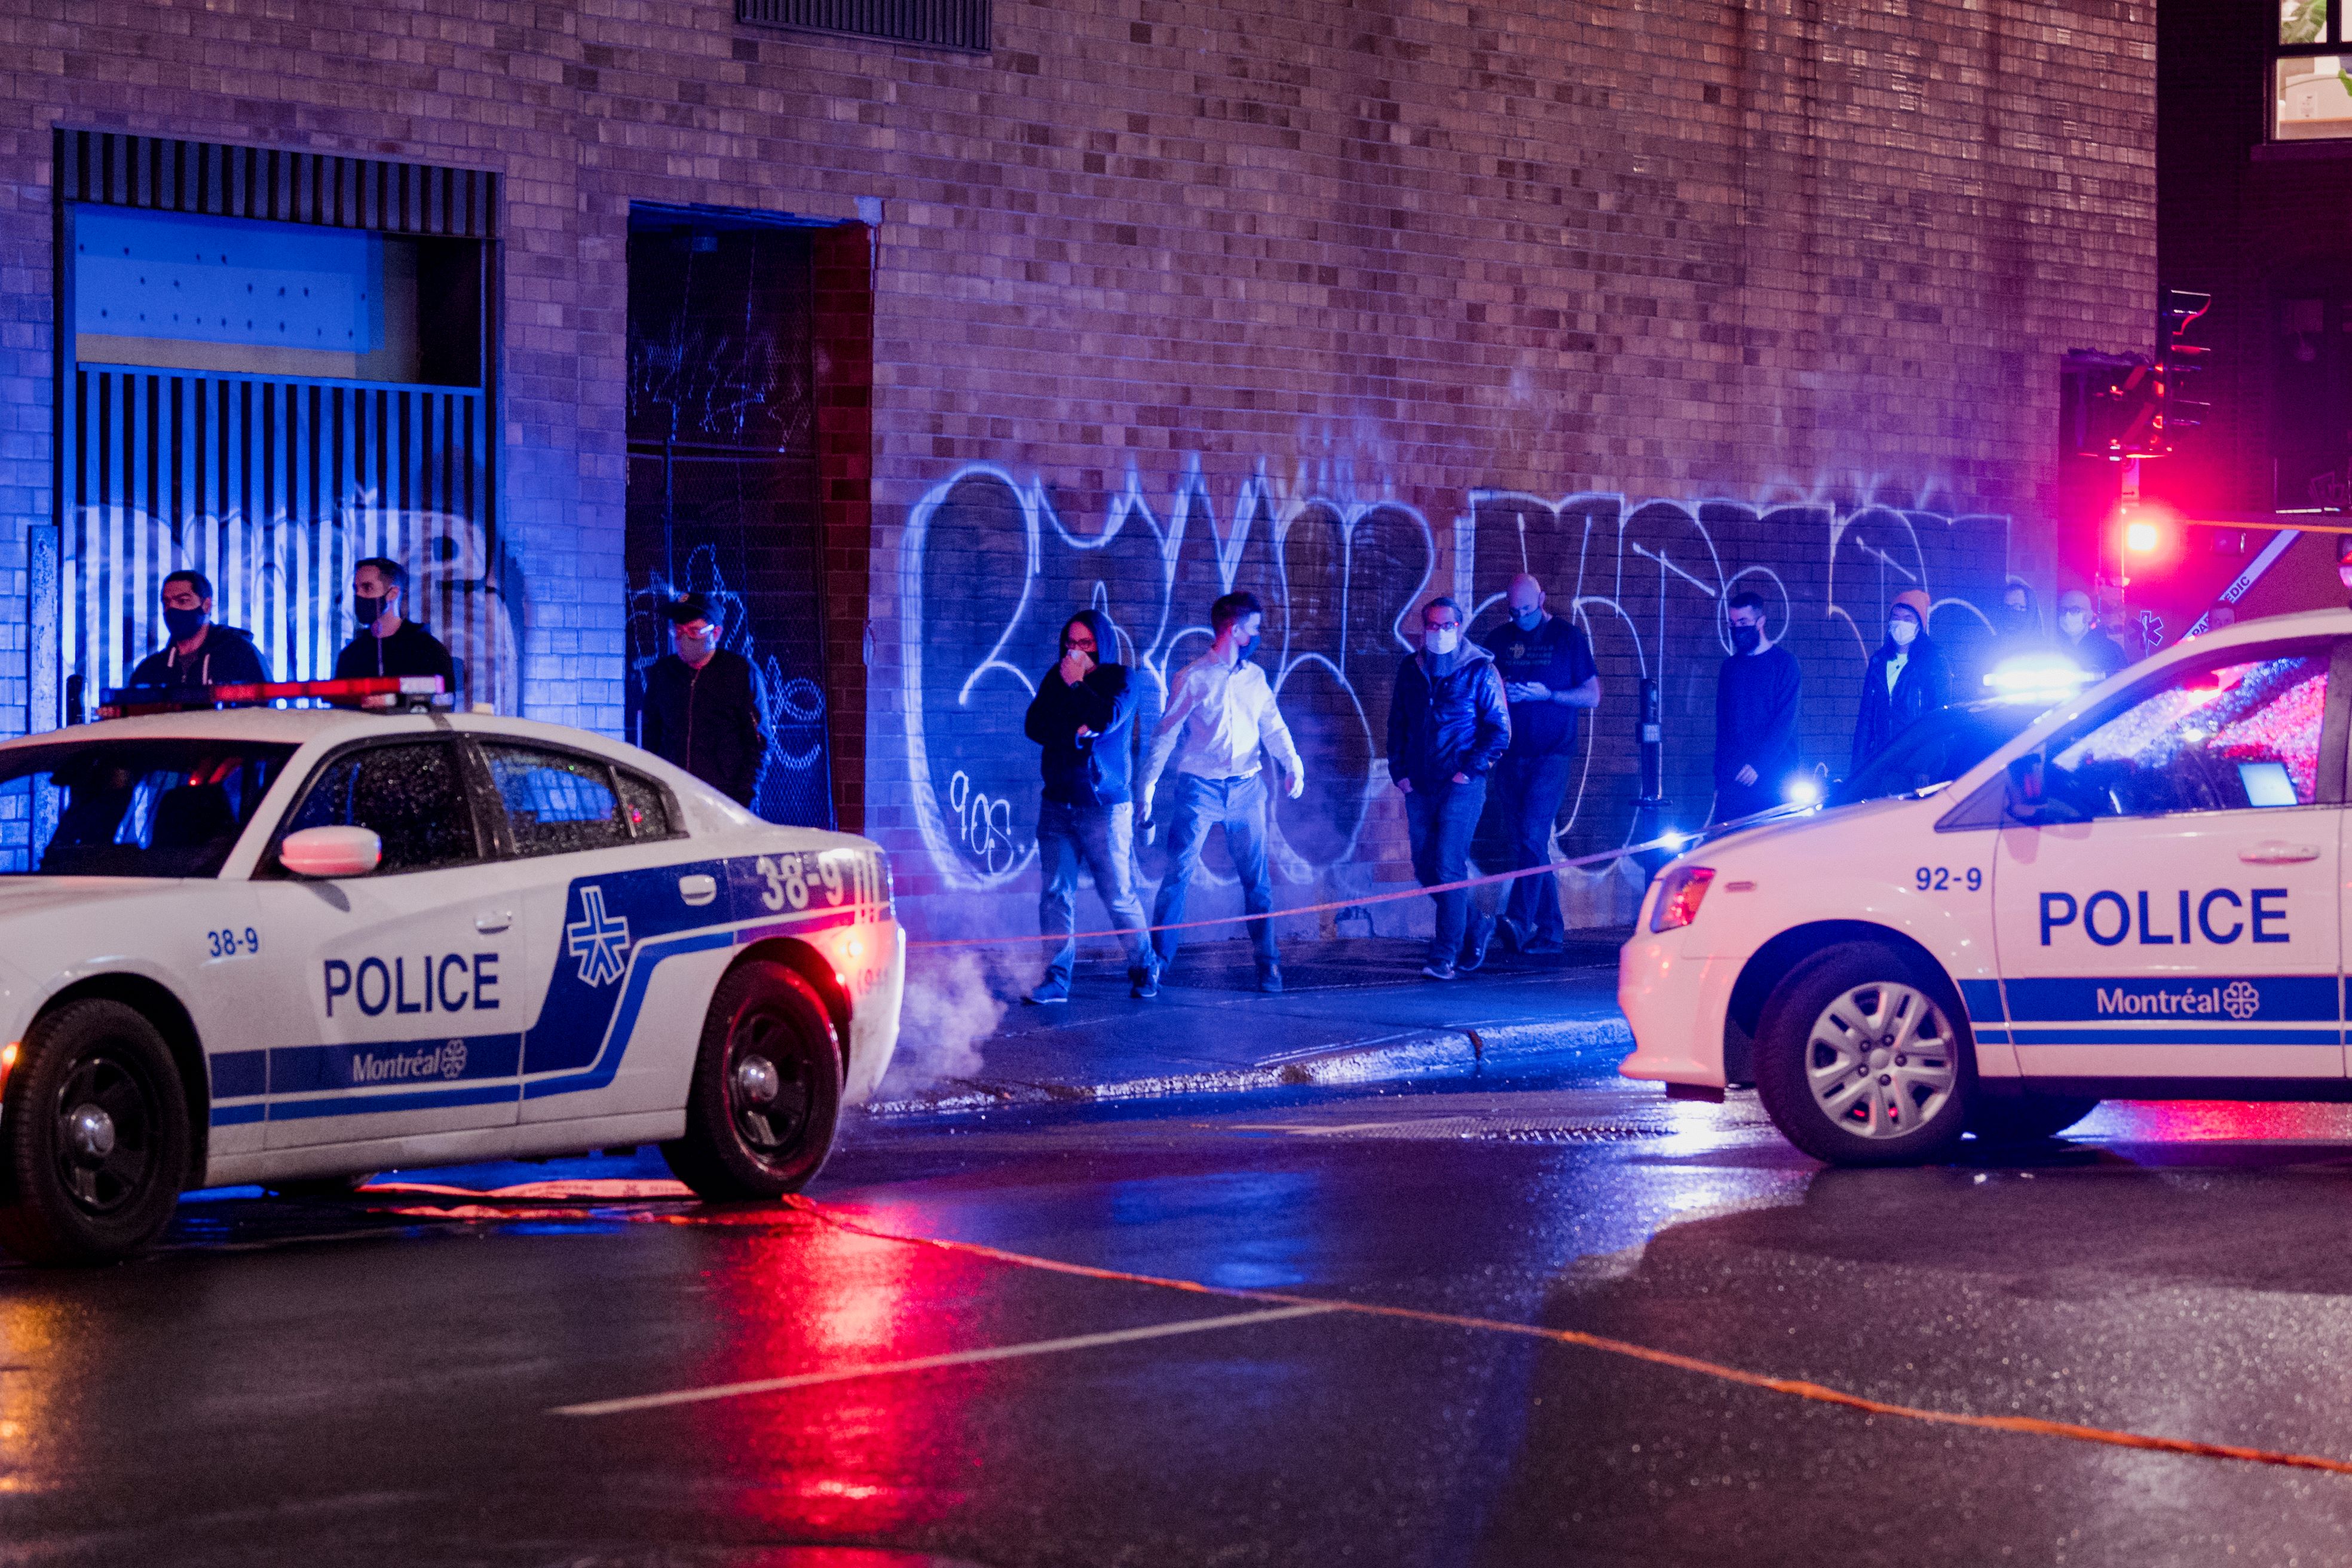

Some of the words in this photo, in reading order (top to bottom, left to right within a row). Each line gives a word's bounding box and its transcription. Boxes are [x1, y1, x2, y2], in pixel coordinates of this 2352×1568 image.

[755, 851, 844, 911] 38-9
[1916, 866, 1982, 892] 92-9
[2039, 887, 2291, 947] POLICE
[207, 926, 260, 957] 38-9
[323, 953, 500, 1018] POLICE
[2096, 987, 2221, 1014] Montréal
[353, 1047, 442, 1083] Montréal
